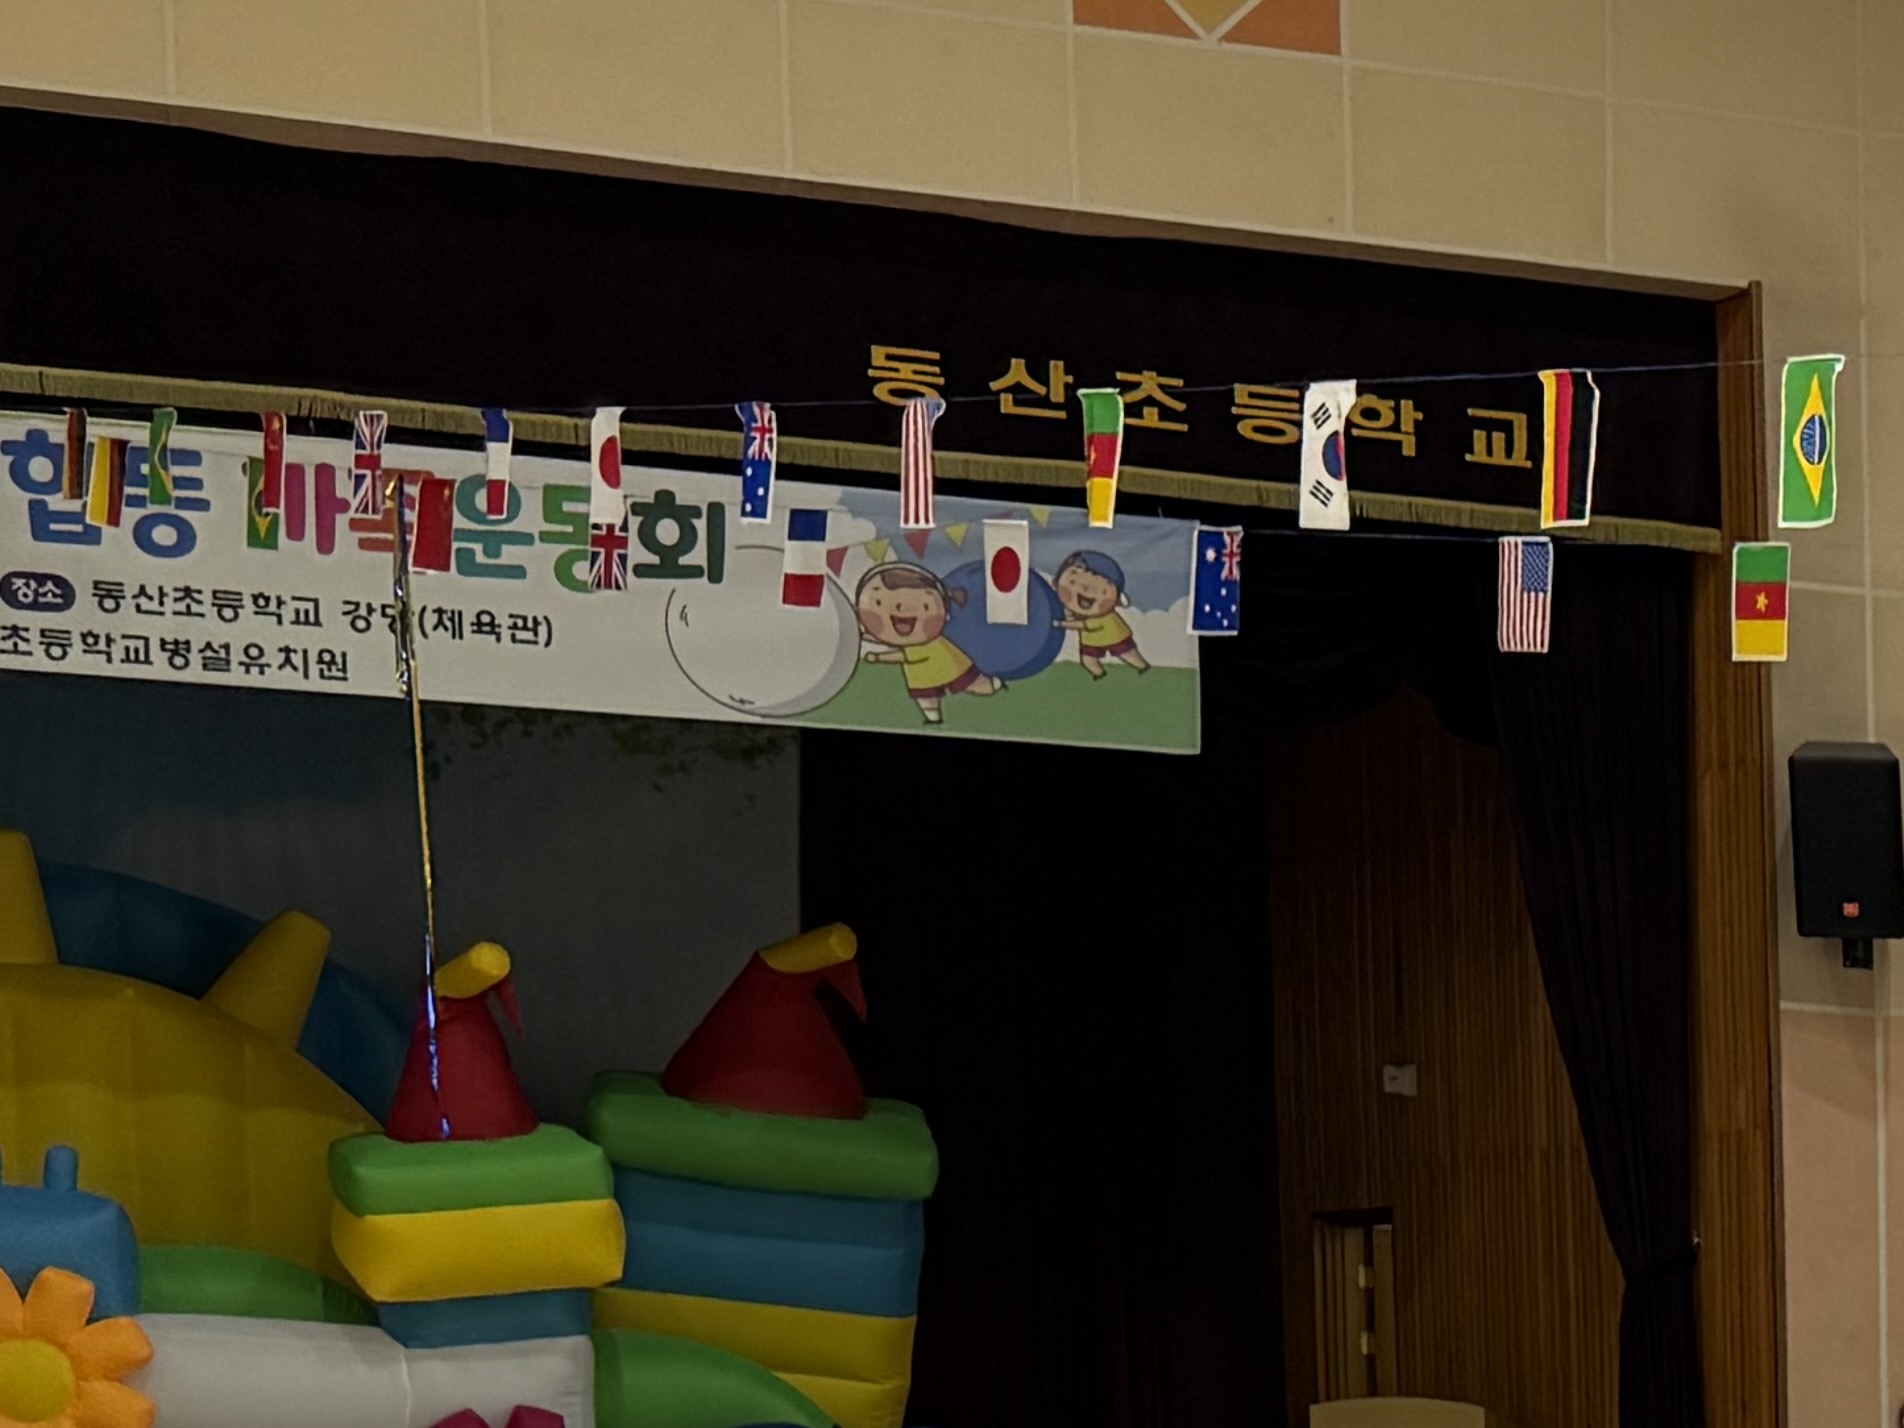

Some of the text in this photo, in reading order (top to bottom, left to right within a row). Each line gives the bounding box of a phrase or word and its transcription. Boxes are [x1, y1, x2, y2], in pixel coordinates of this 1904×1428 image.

[868, 345, 1531, 468] 동산초등학교
[10, 577, 64, 605] 장소
[91, 579, 323, 628] 동산초등학교
[0, 624, 350, 682] 초등학교병설유치원
